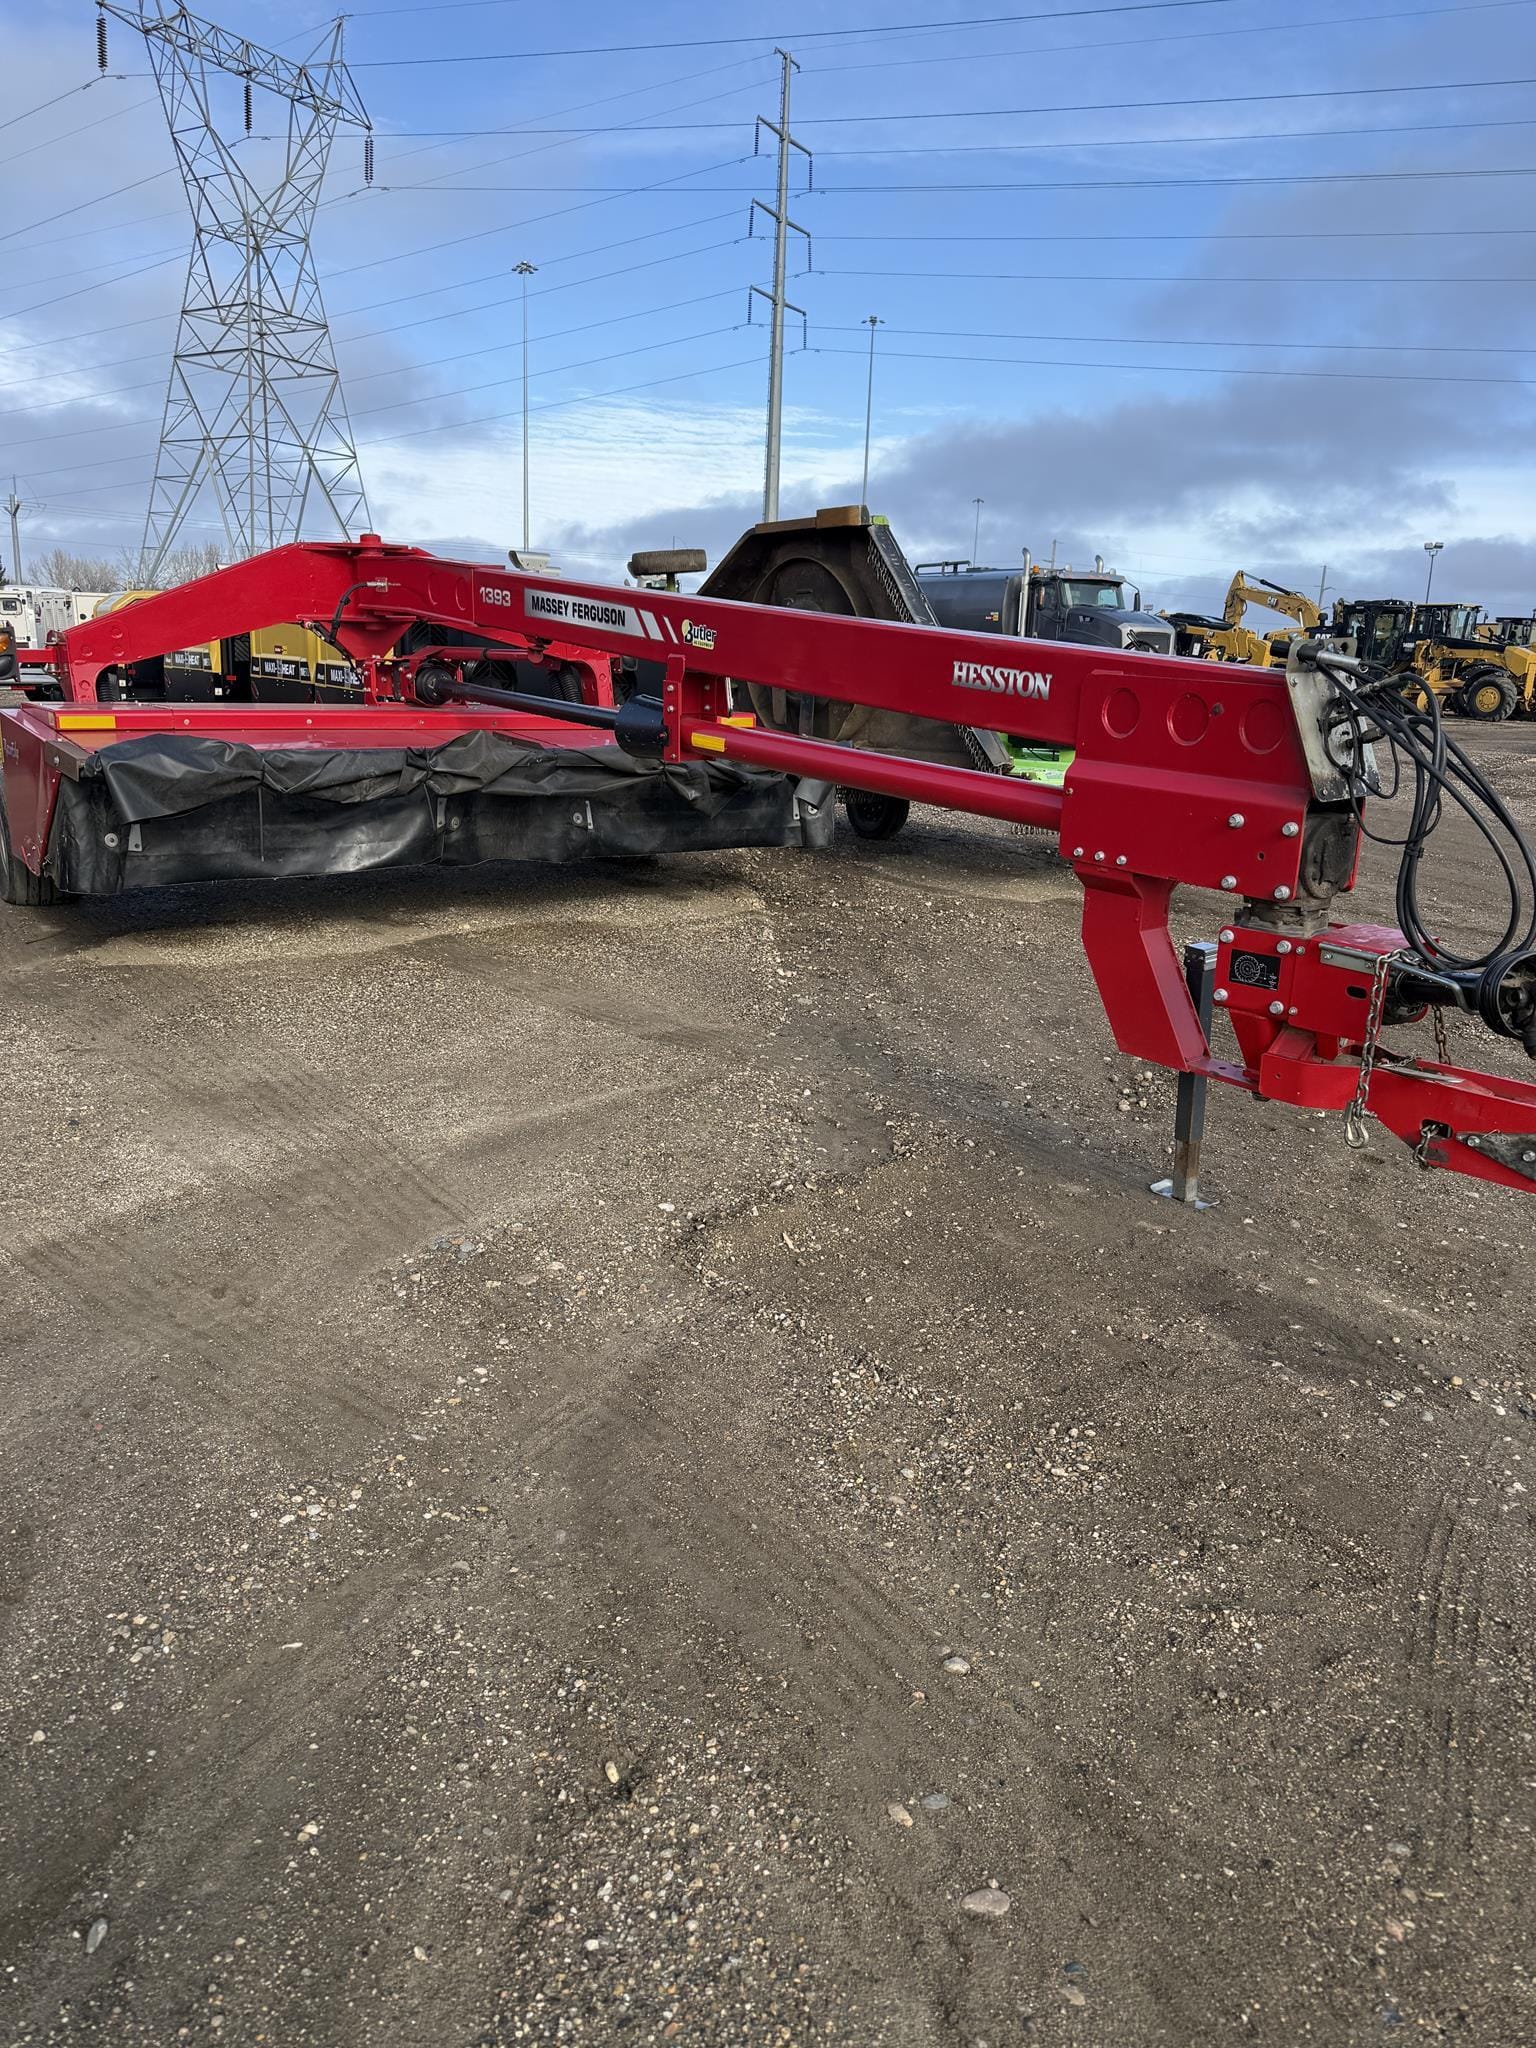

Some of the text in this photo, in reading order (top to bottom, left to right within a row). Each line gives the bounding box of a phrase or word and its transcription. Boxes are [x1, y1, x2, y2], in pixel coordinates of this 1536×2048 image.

[480, 586, 511, 607] 1393
[531, 595, 626, 626] MASSEY FERGUSON
[683, 619, 716, 643] Butler
[952, 660, 1053, 701] HESSTON
